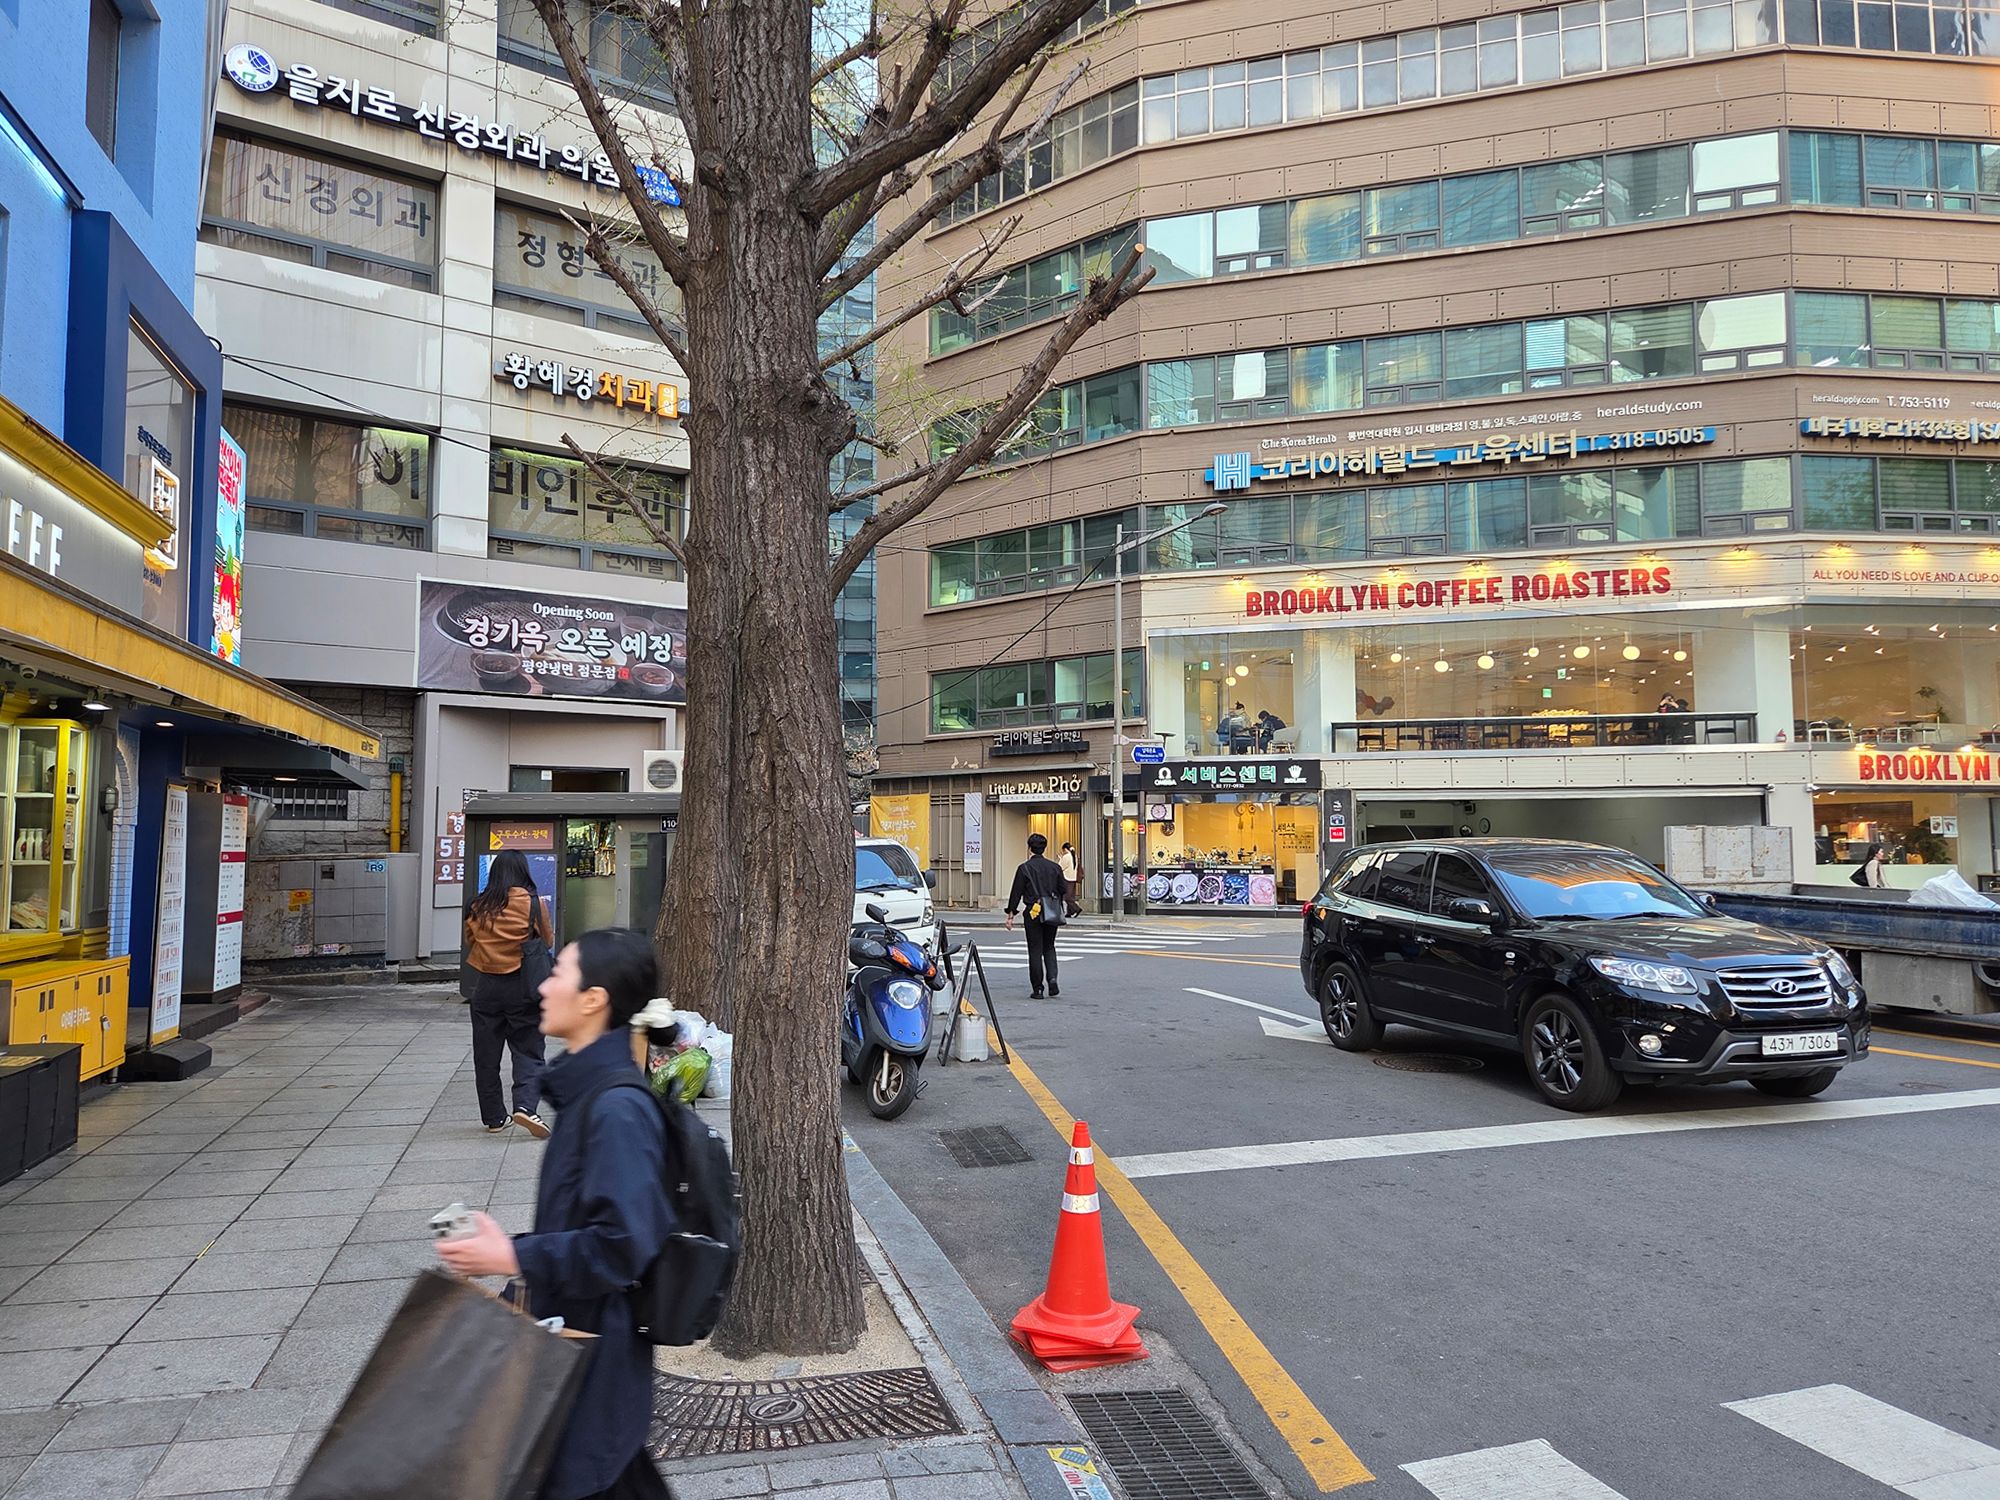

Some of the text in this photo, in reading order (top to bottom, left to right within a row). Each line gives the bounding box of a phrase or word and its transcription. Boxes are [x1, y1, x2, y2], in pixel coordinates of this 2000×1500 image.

[284, 63, 401, 122] 을지로
[413, 101, 551, 170] 신경외과
[256, 163, 431, 239] 신경외과
[517, 231, 661, 297] 정형과
[504, 352, 593, 400] 황혜경
[598, 372, 653, 412] 치과
[1596, 400, 1703, 418] heraldstudy.com
[1900, 396, 1950, 409] 753-5119
[1260, 443, 1440, 480] 코리아헤럴드
[1450, 429, 1577, 464] 교육센터
[1609, 426, 1706, 450] 318-0505
[1813, 570, 1832, 580] ALL
[1836, 571, 1859, 581] YOU
[1861, 571, 1889, 581] NEED
[1892, 572, 1901, 581] IS
[1904, 572, 1931, 582] LOVE
[1934, 573, 1956, 583] AND
[1958, 573, 1967, 582] A
[1967, 573, 1989, 583] CUP
[1246, 567, 1672, 617] BROOKLYN COFFEE ROASTERS
[533, 602, 614, 621] Opening Soon
[464, 616, 673, 663] 경기옥 오픈 예정
[522, 659, 574, 677] 평양냉면
[1181, 765, 1277, 784] 서비스센터
[1860, 755, 1991, 781] BROOKLYN
[988, 783, 1015, 794] Little
[1018, 782, 1044, 794] PAPA
[370, 864, 384, 872] R9
[1799, 1035, 1831, 1050] 7306
